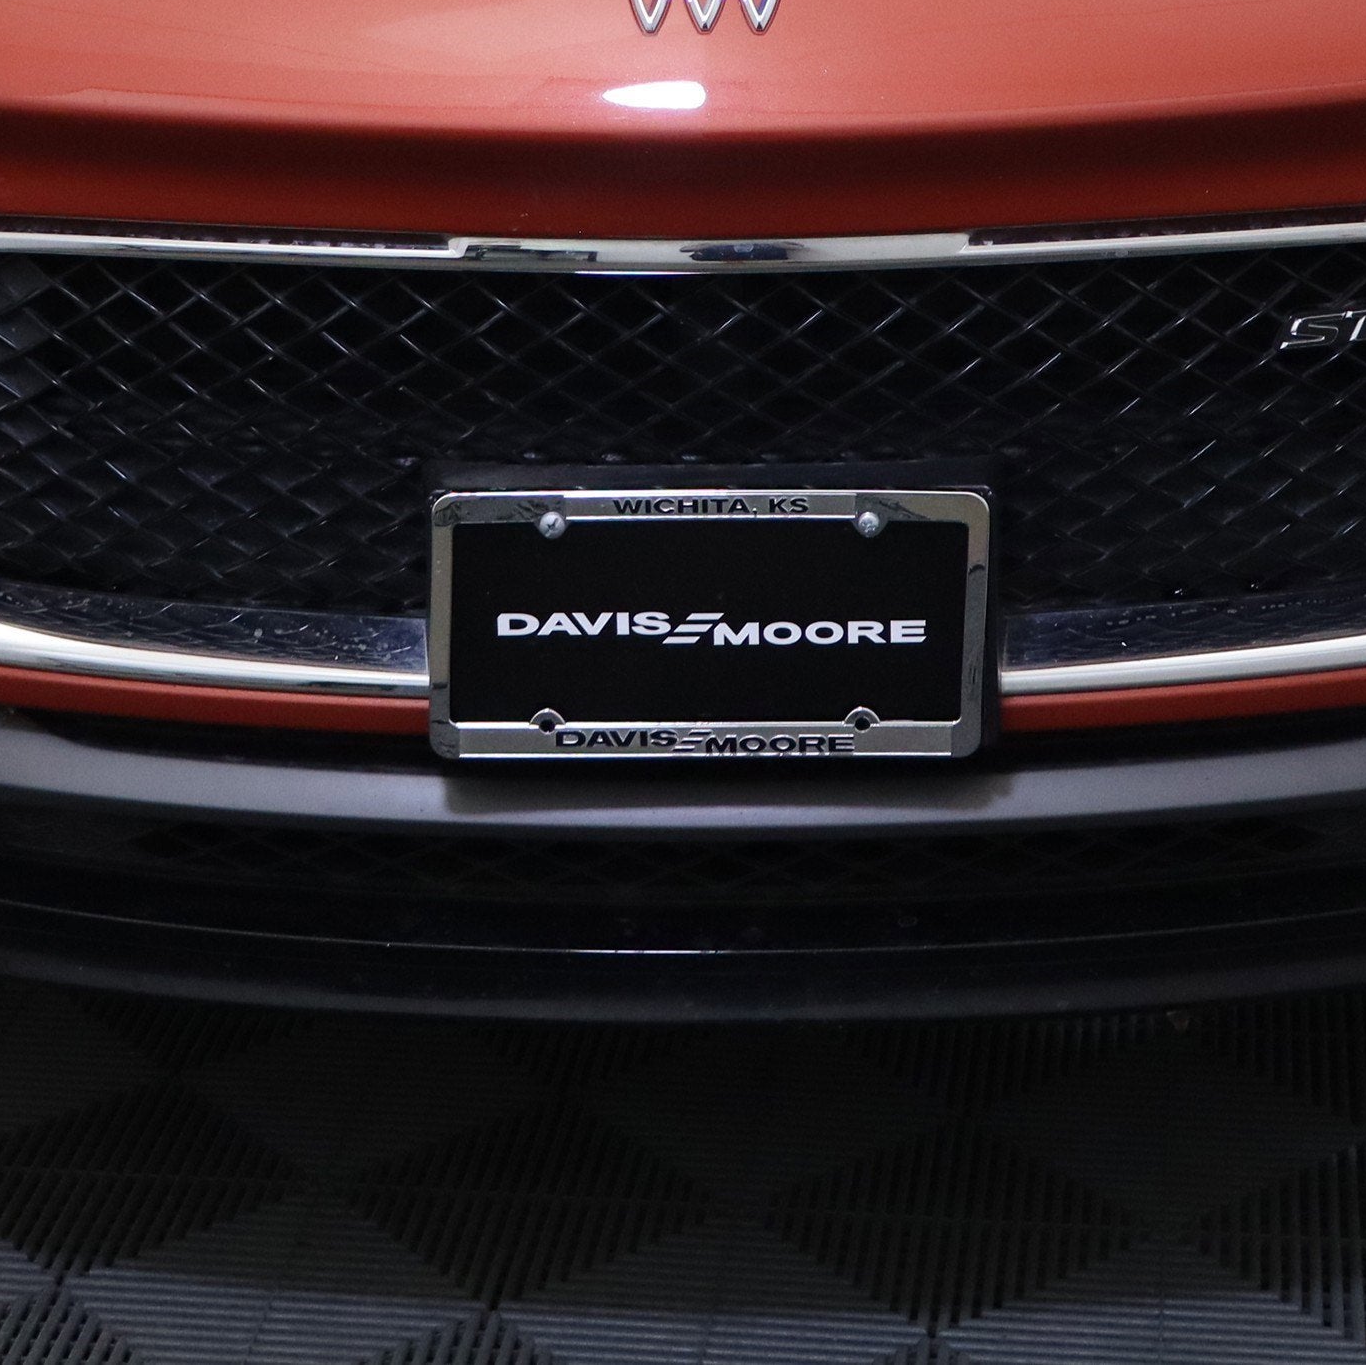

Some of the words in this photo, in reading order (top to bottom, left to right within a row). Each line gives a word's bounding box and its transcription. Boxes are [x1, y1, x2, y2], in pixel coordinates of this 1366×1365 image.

[769, 498, 809, 514] KS
[496, 611, 670, 637] DAVIS
[713, 619, 928, 646] MOORE
[554, 729, 678, 748] DAVIS
[704, 734, 855, 754] MOORE
